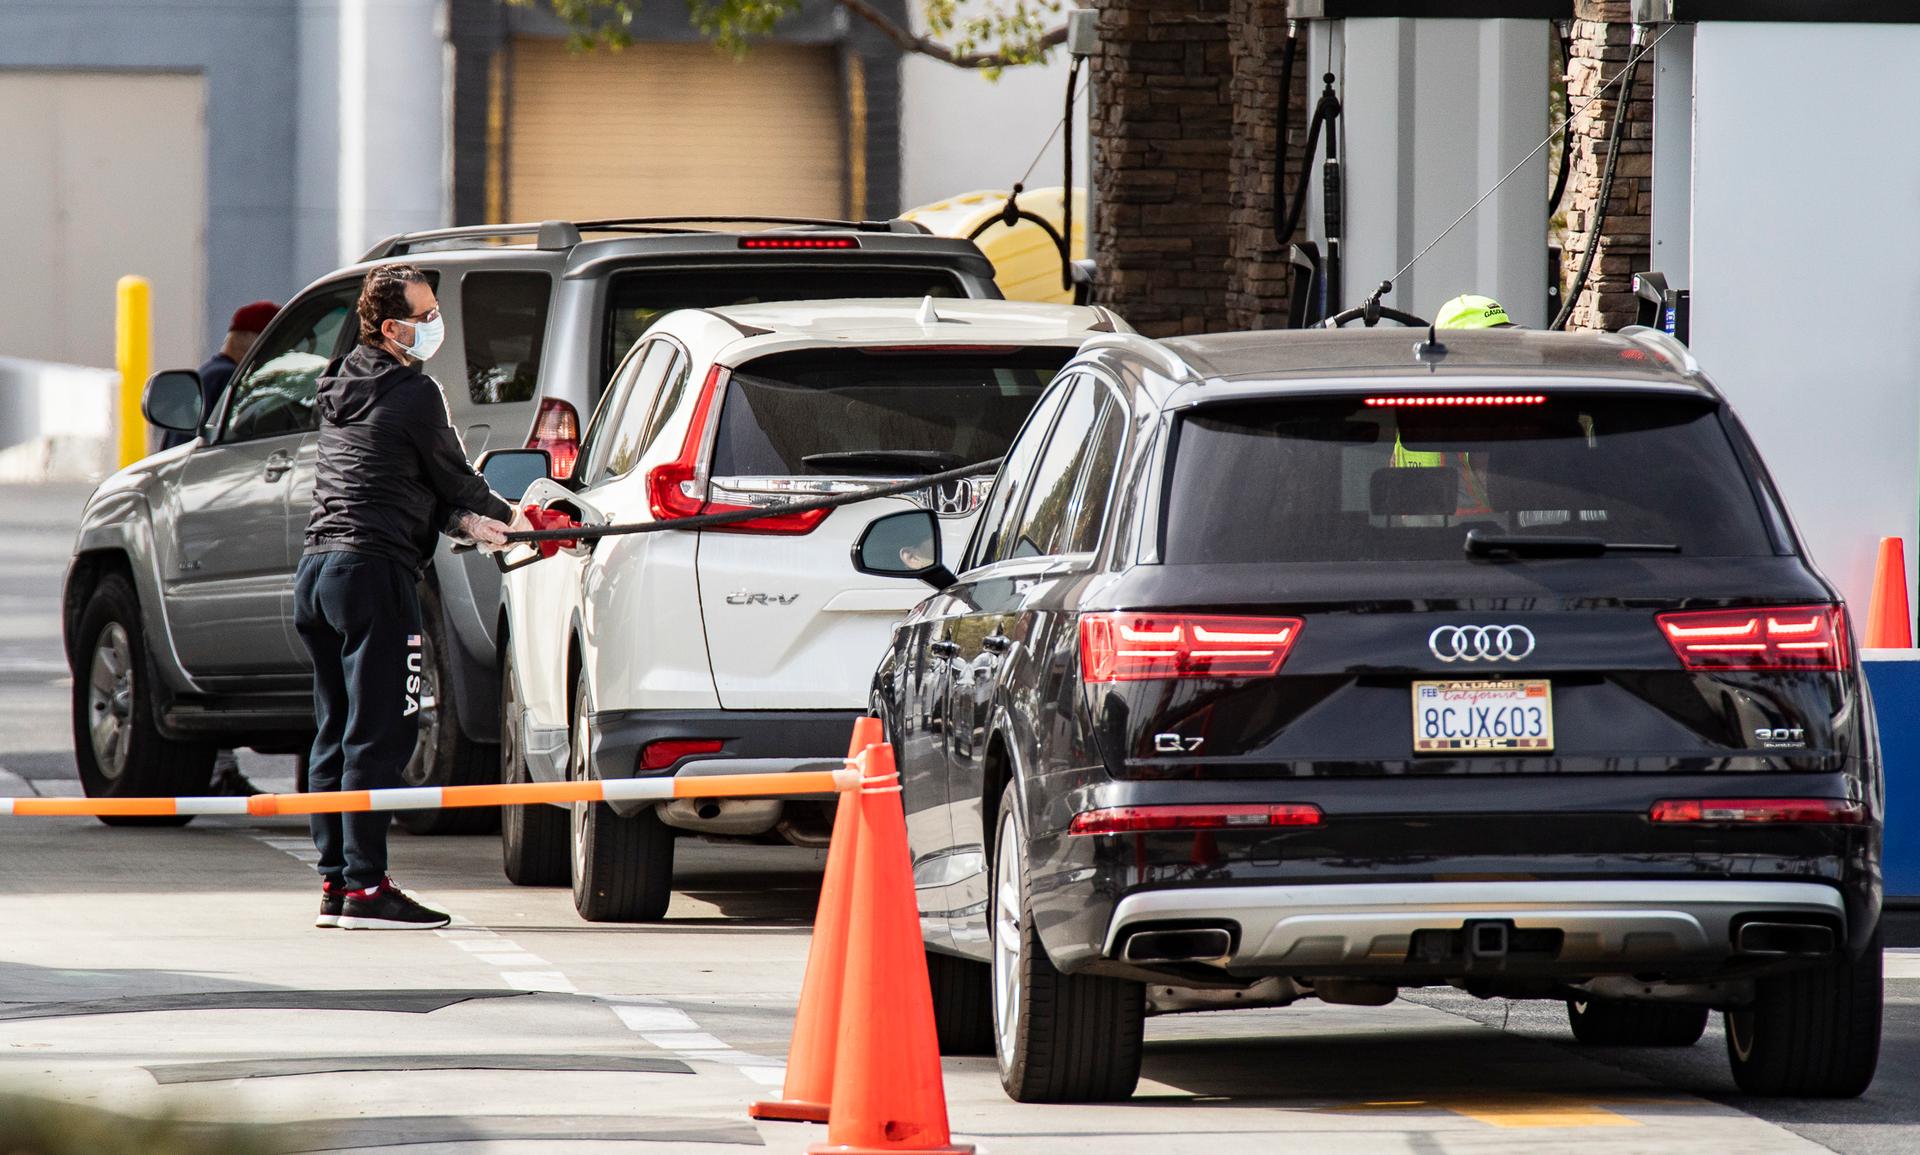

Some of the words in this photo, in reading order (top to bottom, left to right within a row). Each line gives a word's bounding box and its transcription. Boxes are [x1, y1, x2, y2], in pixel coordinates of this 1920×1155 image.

[726, 592, 800, 606] CR-V
[404, 653, 421, 716] USA
[1451, 681, 1513, 689] ALUMNI
[1421, 687, 1438, 697] FEB
[1444, 690, 1518, 704] California
[1426, 707, 1542, 738] 8CJX603
[1155, 733, 1204, 751] Q7
[1461, 739, 1508, 748] USC
